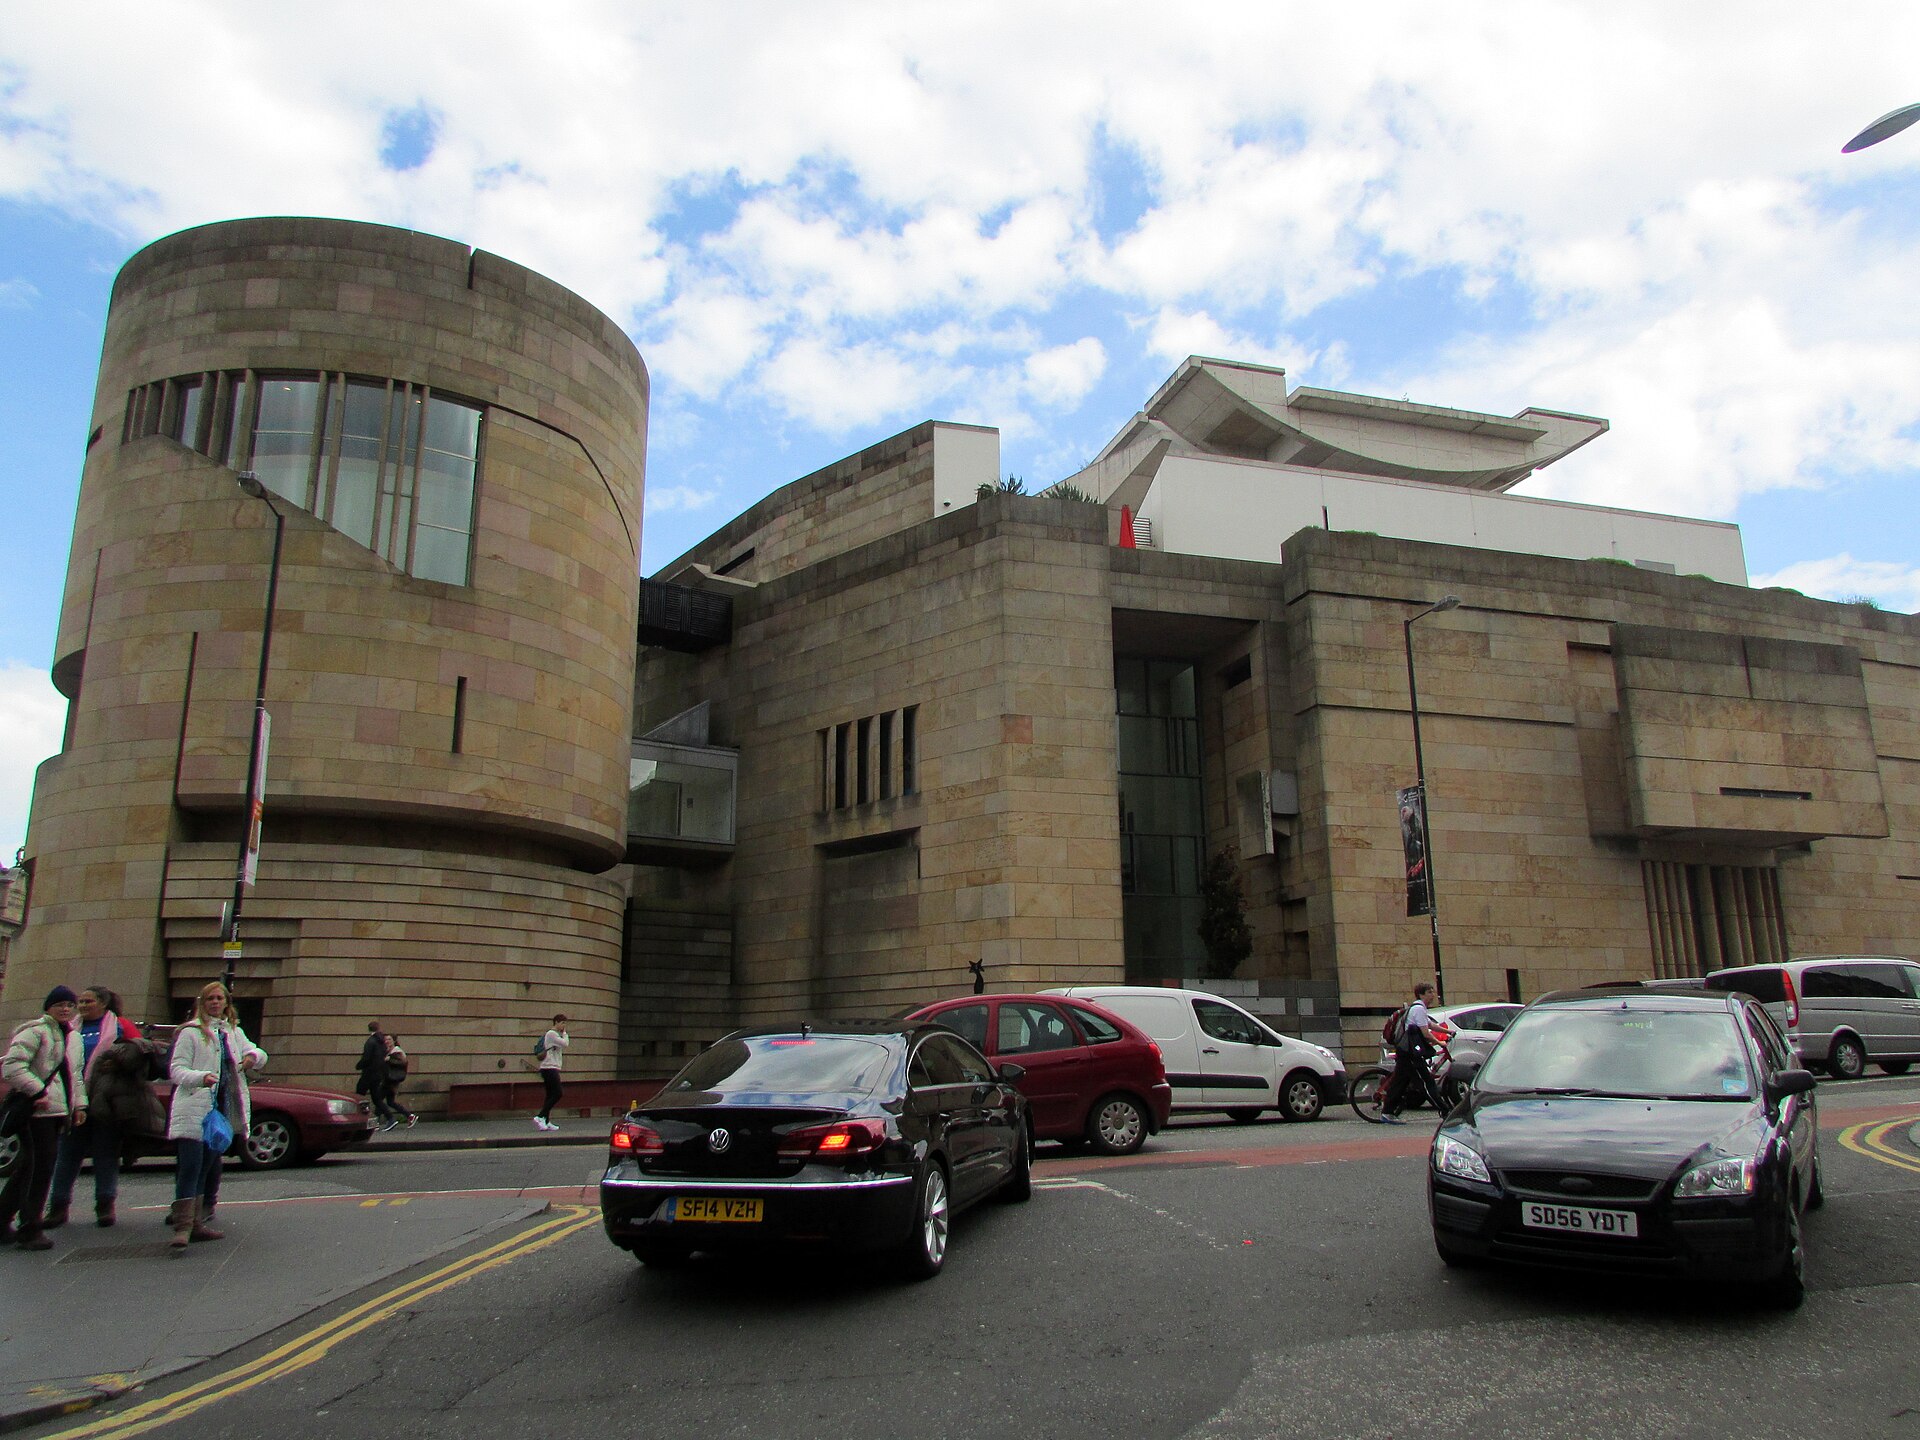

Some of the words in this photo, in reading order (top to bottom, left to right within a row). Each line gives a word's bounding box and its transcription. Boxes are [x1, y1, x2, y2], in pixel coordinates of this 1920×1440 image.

[682, 1199, 719, 1217] SF14
[725, 1200, 757, 1218] VZH
[1531, 1206, 1582, 1228] SD56
[1588, 1211, 1629, 1232] YDT
